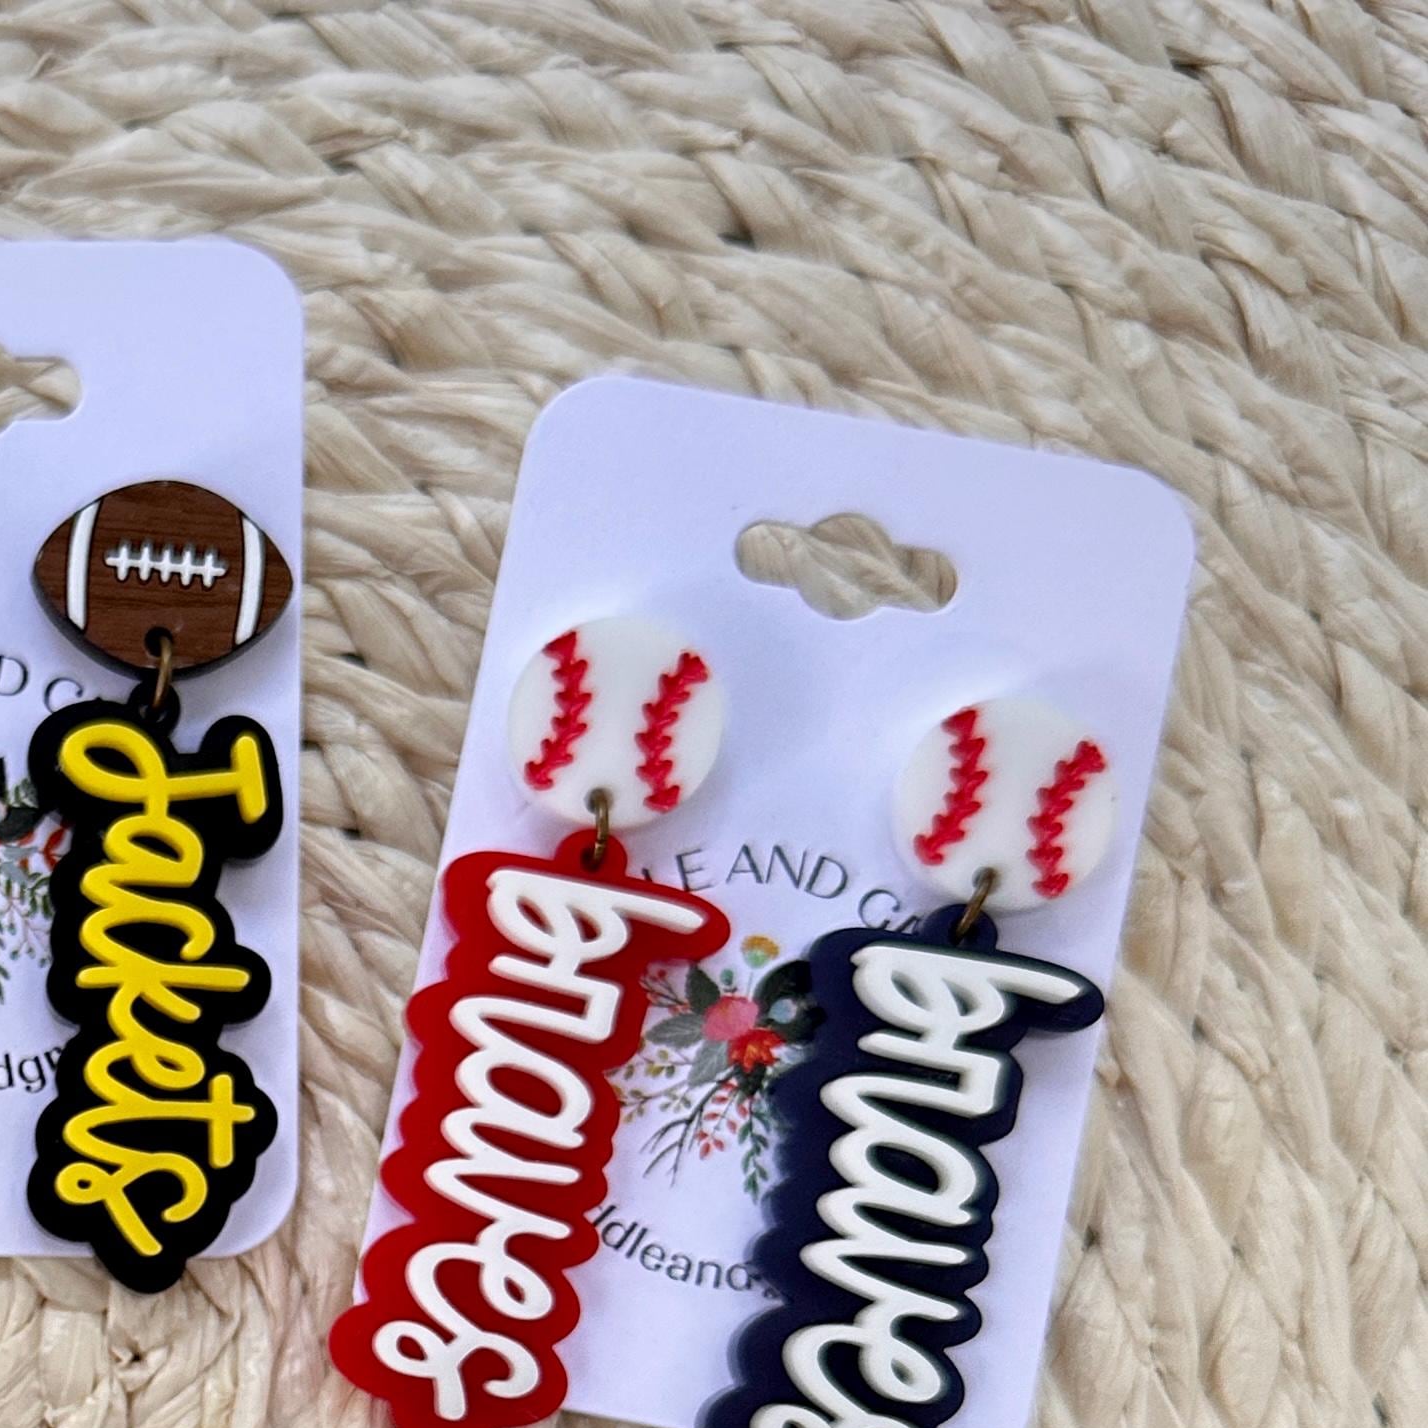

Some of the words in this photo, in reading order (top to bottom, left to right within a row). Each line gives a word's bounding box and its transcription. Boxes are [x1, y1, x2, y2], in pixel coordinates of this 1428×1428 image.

[55, 724, 267, 1255] Jackets
[726, 843, 848, 899] AND
[373, 869, 706, 1421] braves
